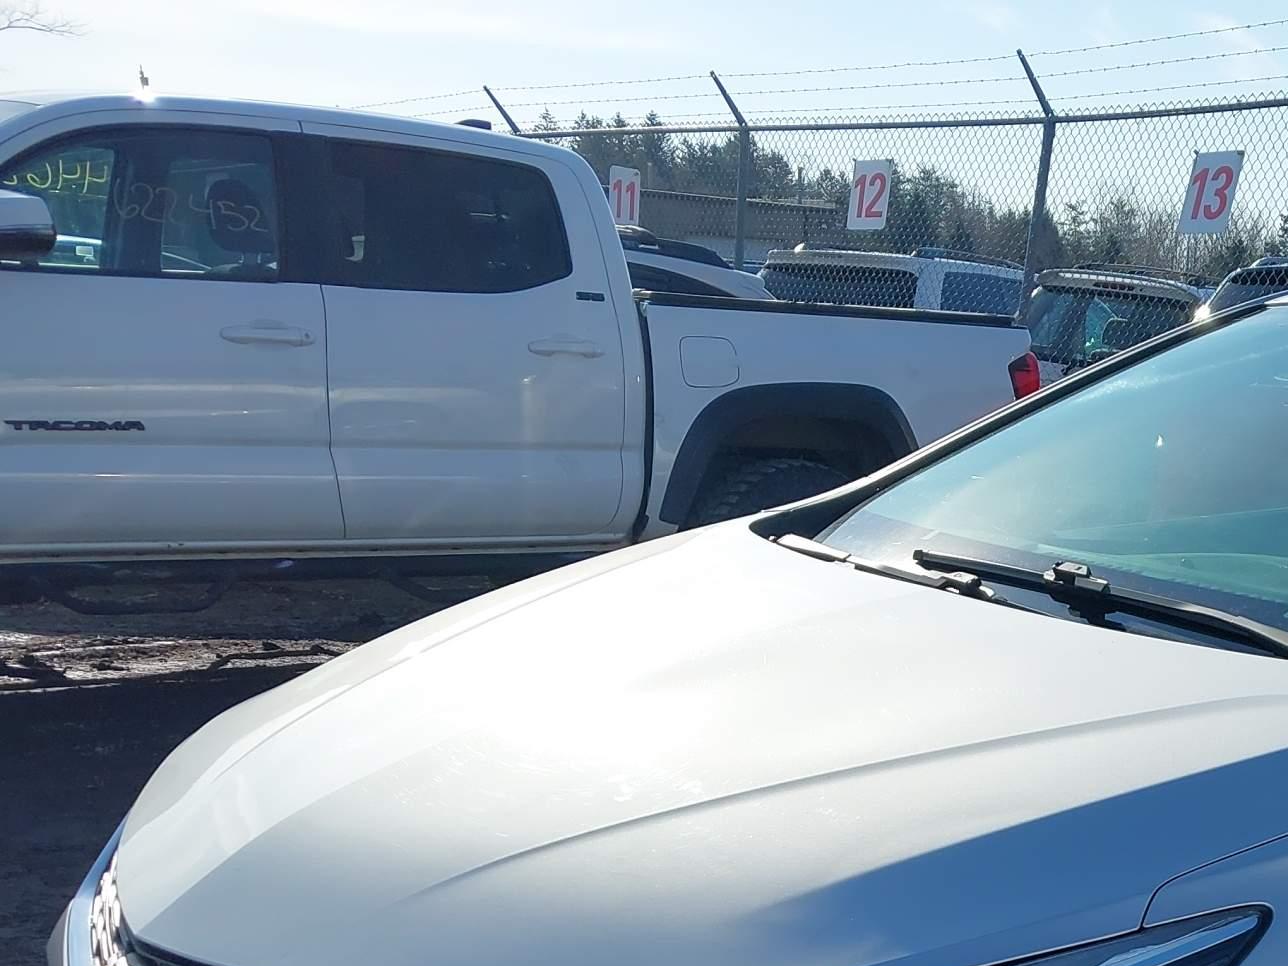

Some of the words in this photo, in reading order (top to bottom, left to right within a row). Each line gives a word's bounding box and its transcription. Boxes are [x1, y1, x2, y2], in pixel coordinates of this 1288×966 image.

[611, 178, 637, 221] 11
[853, 171, 888, 220] 12
[1190, 164, 1235, 221] 13
[3, 420, 146, 431] TACOMA
